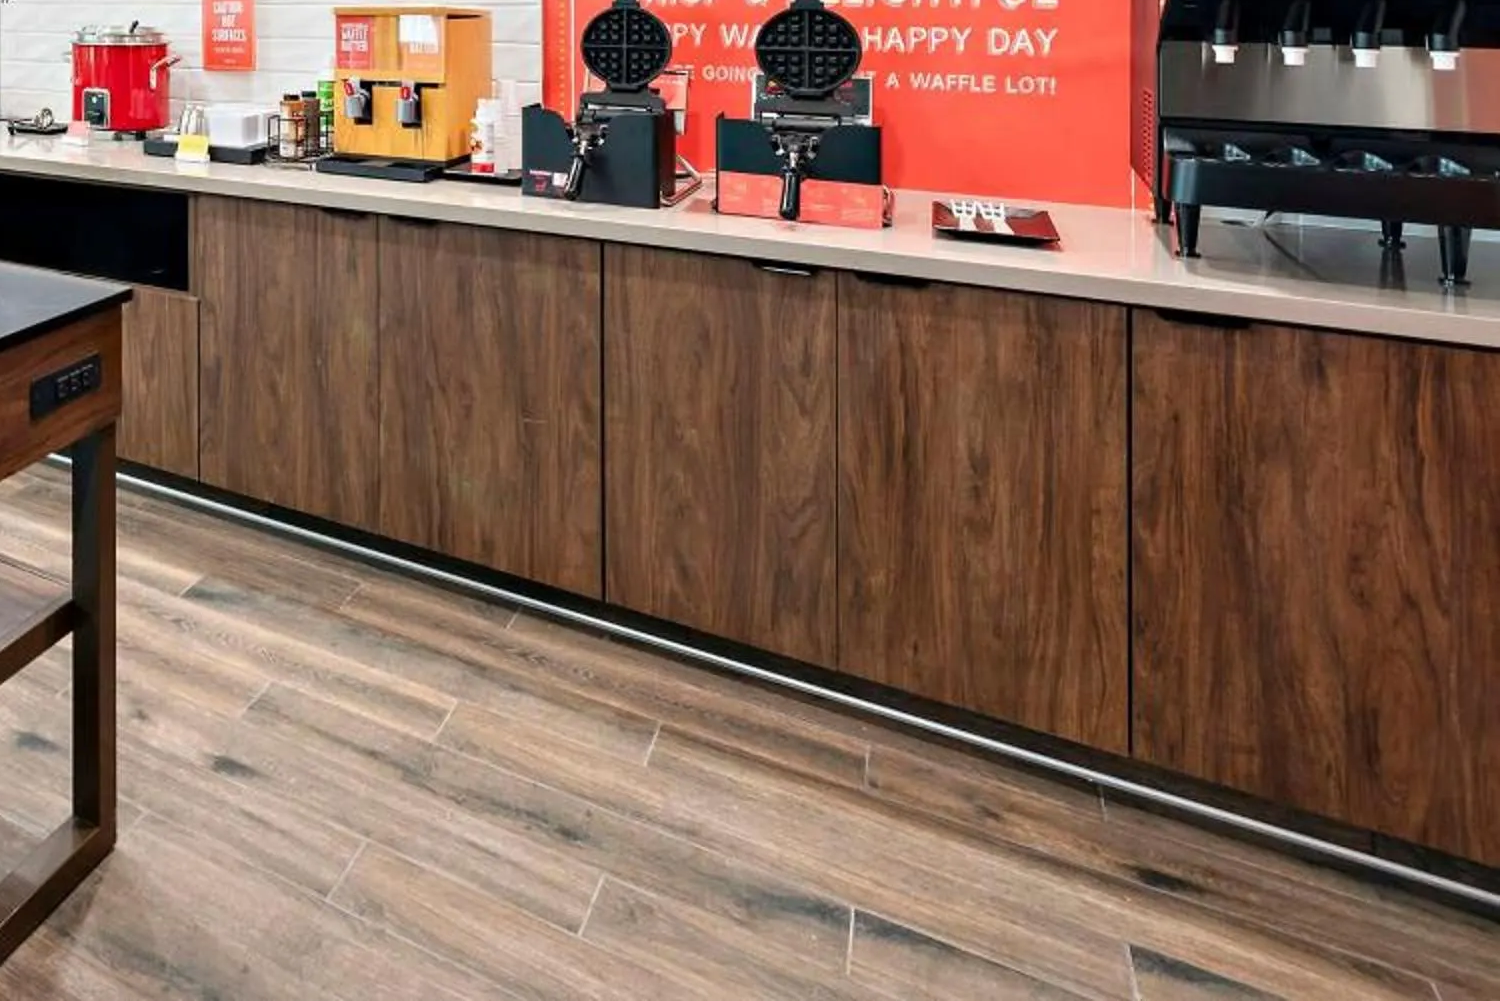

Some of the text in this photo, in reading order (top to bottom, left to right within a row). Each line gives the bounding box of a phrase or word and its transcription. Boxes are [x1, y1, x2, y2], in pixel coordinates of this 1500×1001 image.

[862, 26, 1058, 57] HAPPY DAY
[884, 72, 1058, 95] A WAFFLE LOT!
